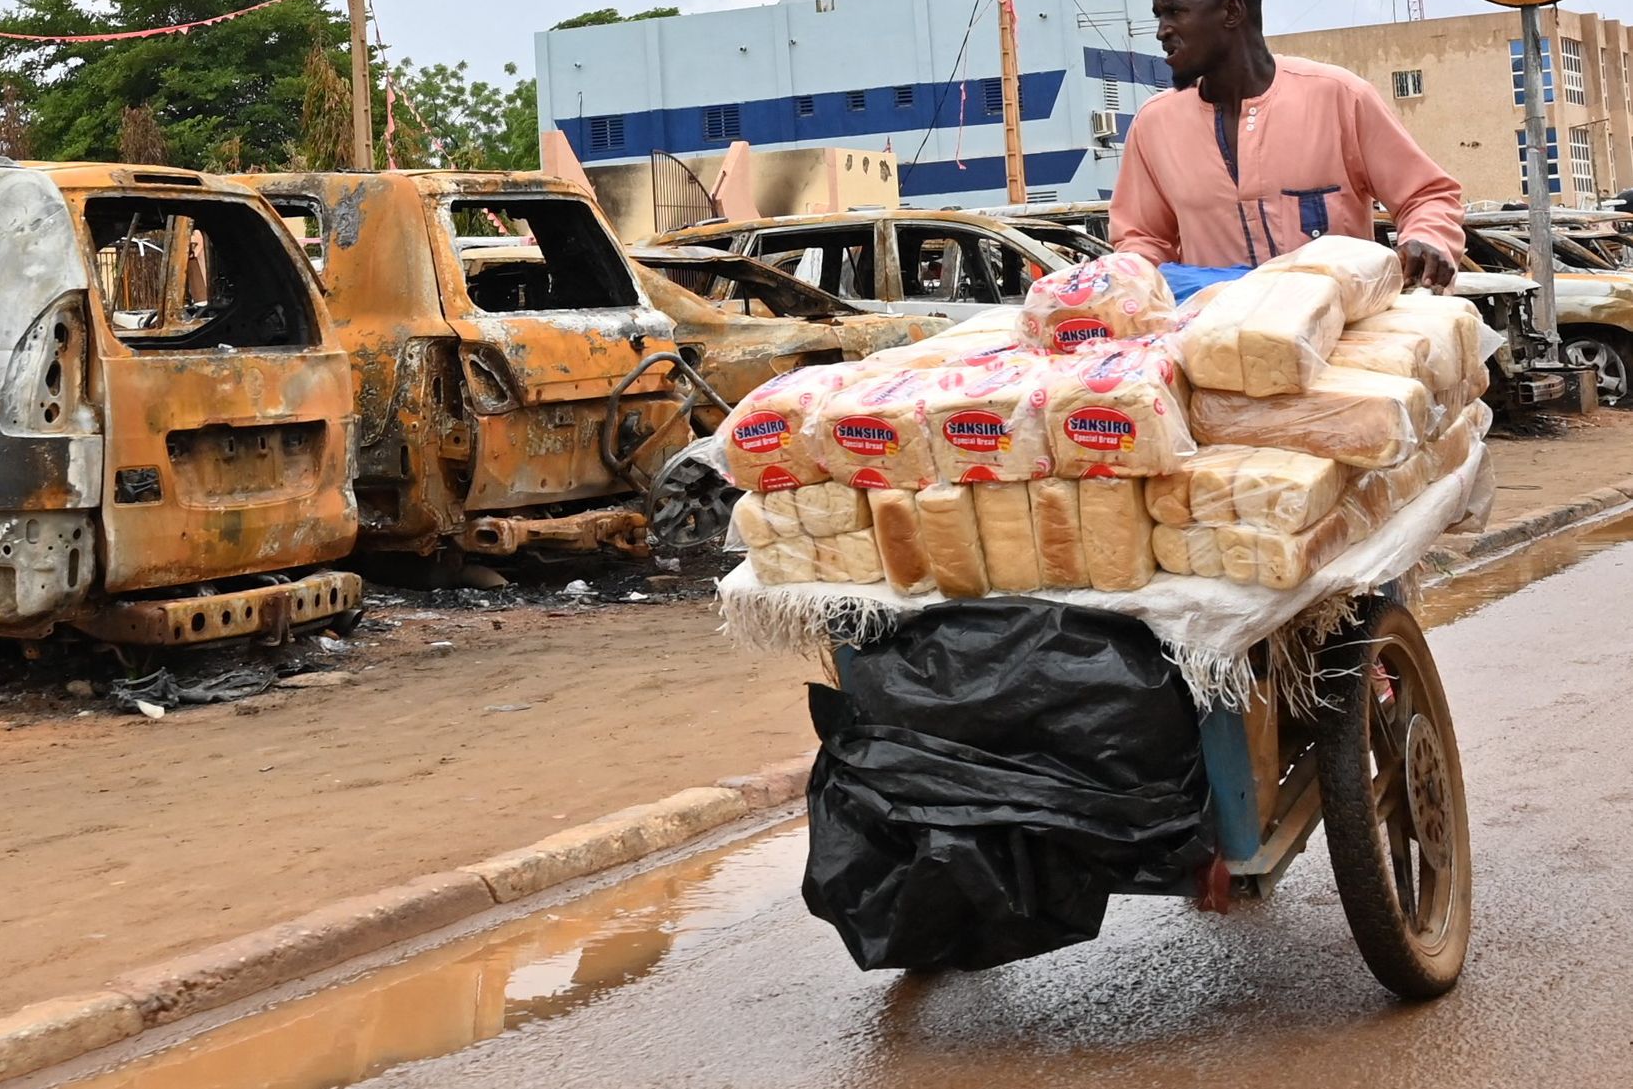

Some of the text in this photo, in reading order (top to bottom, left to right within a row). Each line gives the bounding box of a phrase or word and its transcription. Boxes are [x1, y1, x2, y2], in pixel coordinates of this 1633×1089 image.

[735, 420, 786, 439] SANSIRO
[838, 425, 893, 441] SANSIRO
[1069, 418, 1131, 434] SANSIRO
